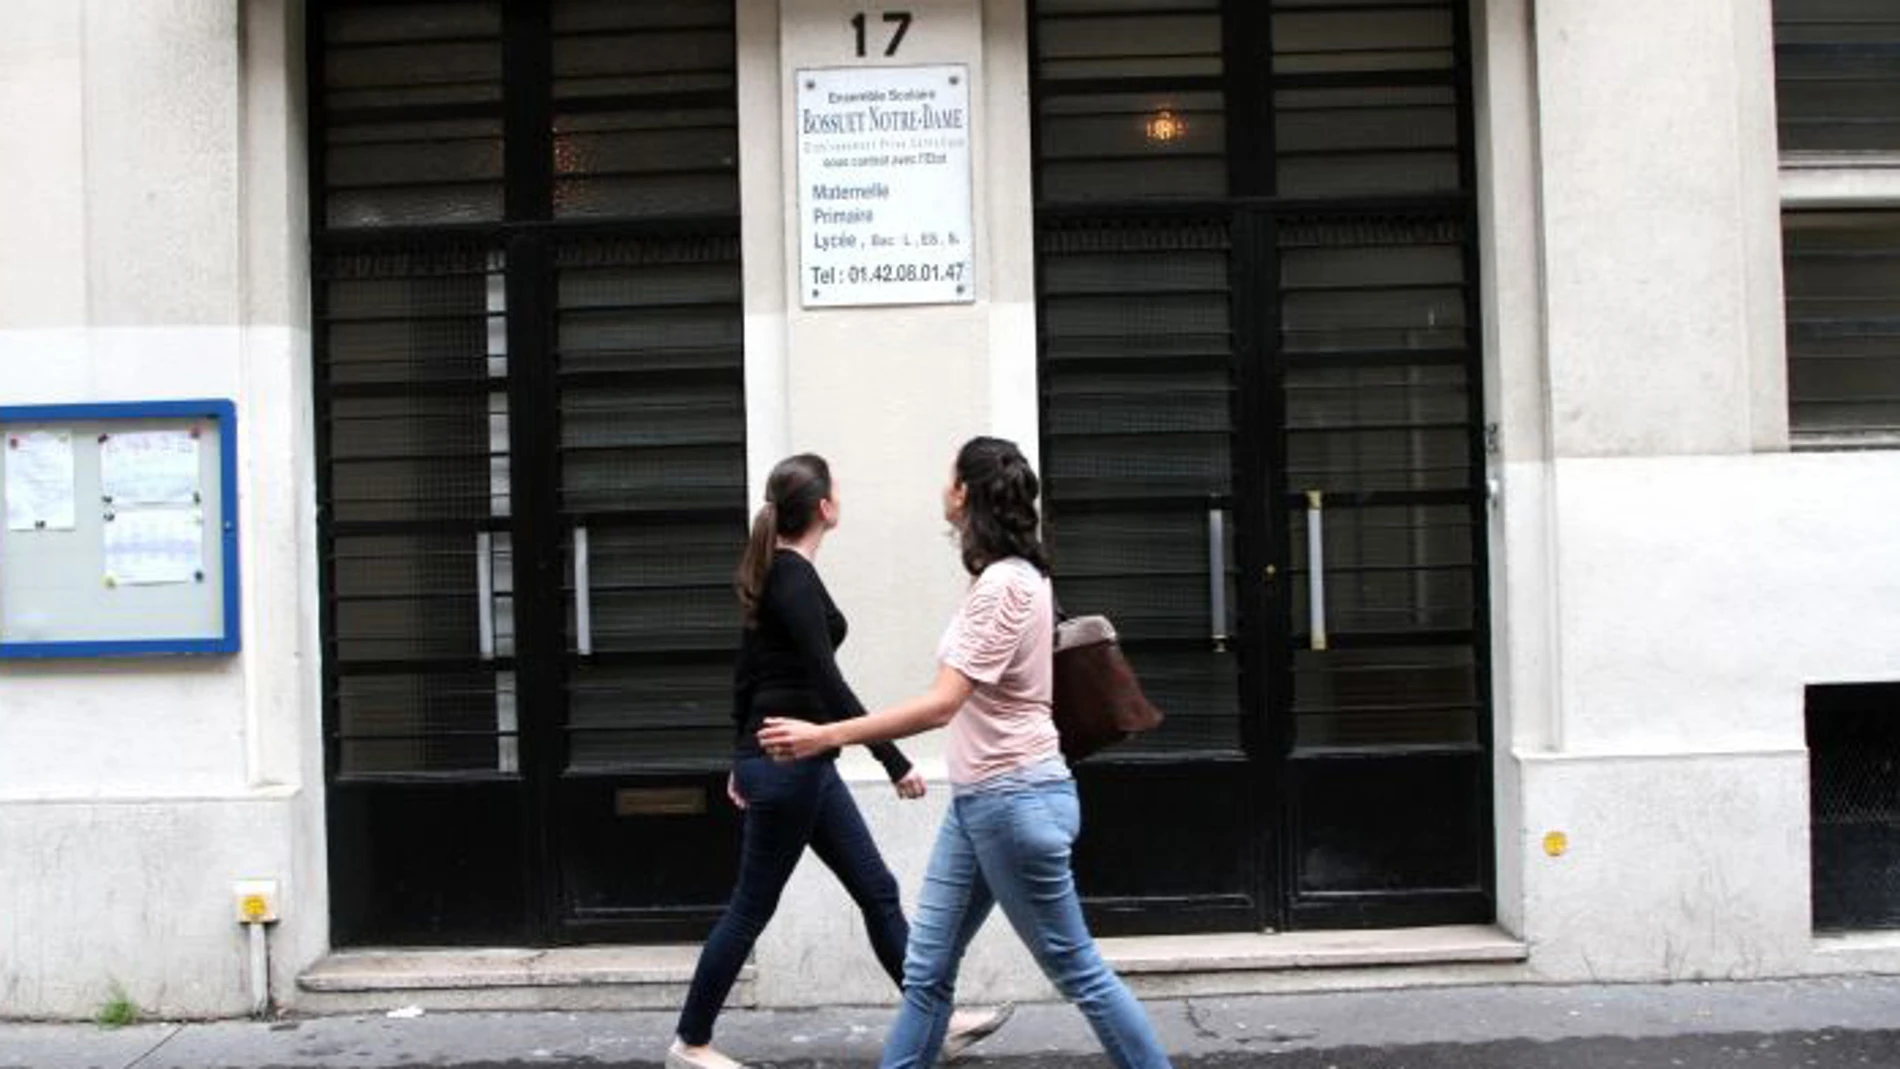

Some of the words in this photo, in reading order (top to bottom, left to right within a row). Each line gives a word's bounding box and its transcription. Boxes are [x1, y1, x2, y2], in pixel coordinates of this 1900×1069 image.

[851, 12, 913, 58] 17
[812, 182, 889, 200] Maternelle
[813, 207, 873, 224] Primaire
